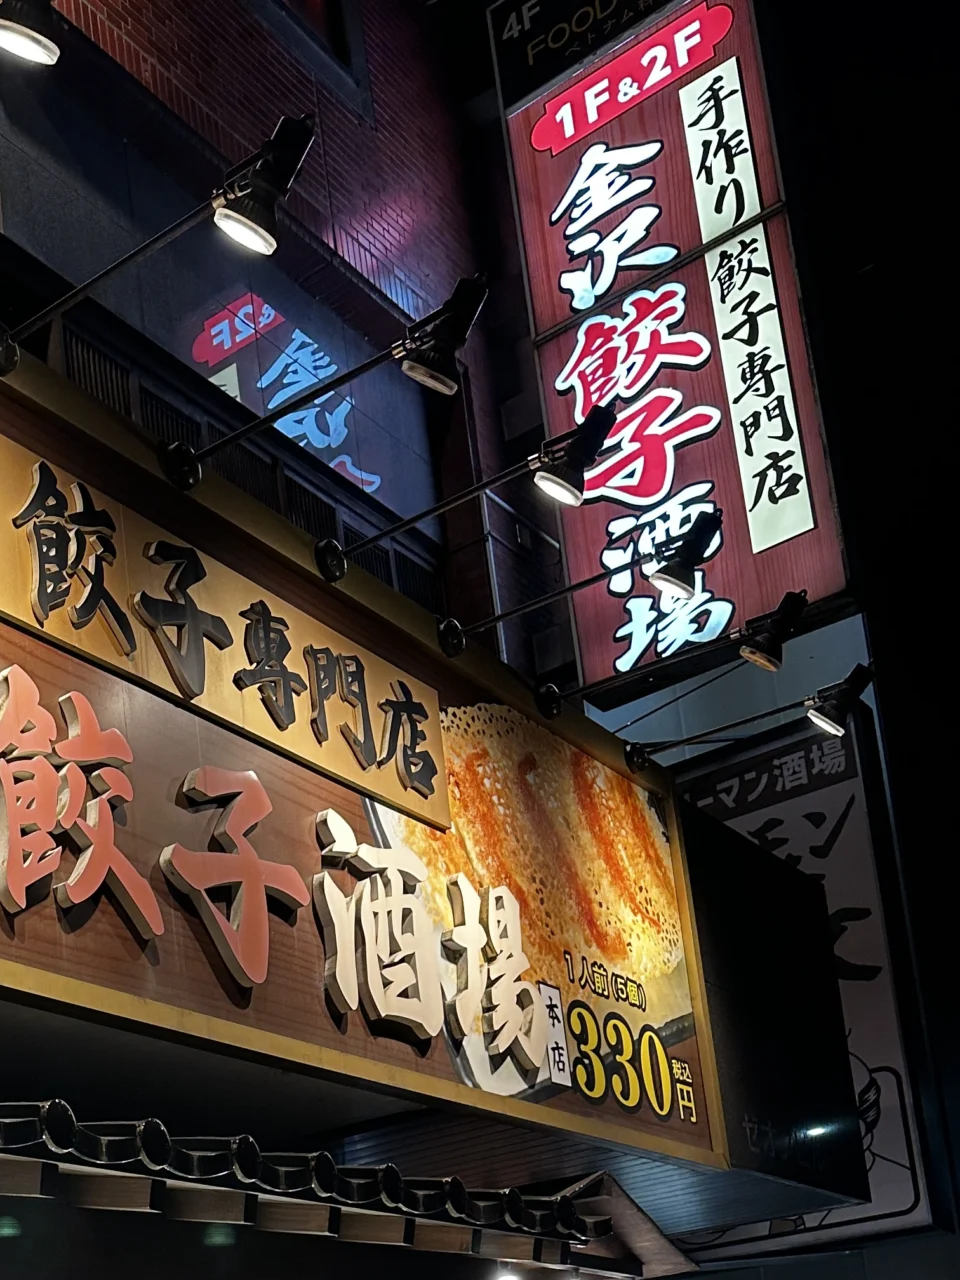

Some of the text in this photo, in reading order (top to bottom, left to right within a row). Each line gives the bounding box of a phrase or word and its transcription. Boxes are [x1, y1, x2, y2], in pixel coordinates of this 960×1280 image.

[554, 19, 702, 138] 1F&2F
[687, 75, 803, 511] 手作り餃子専門店
[550, 140, 736, 673] 金沢餃子酒場
[685, 740, 848, 808] ーマン酒場
[546, 997, 567, 1075] 本店
[569, 1005, 697, 1123] 330 税込 円
